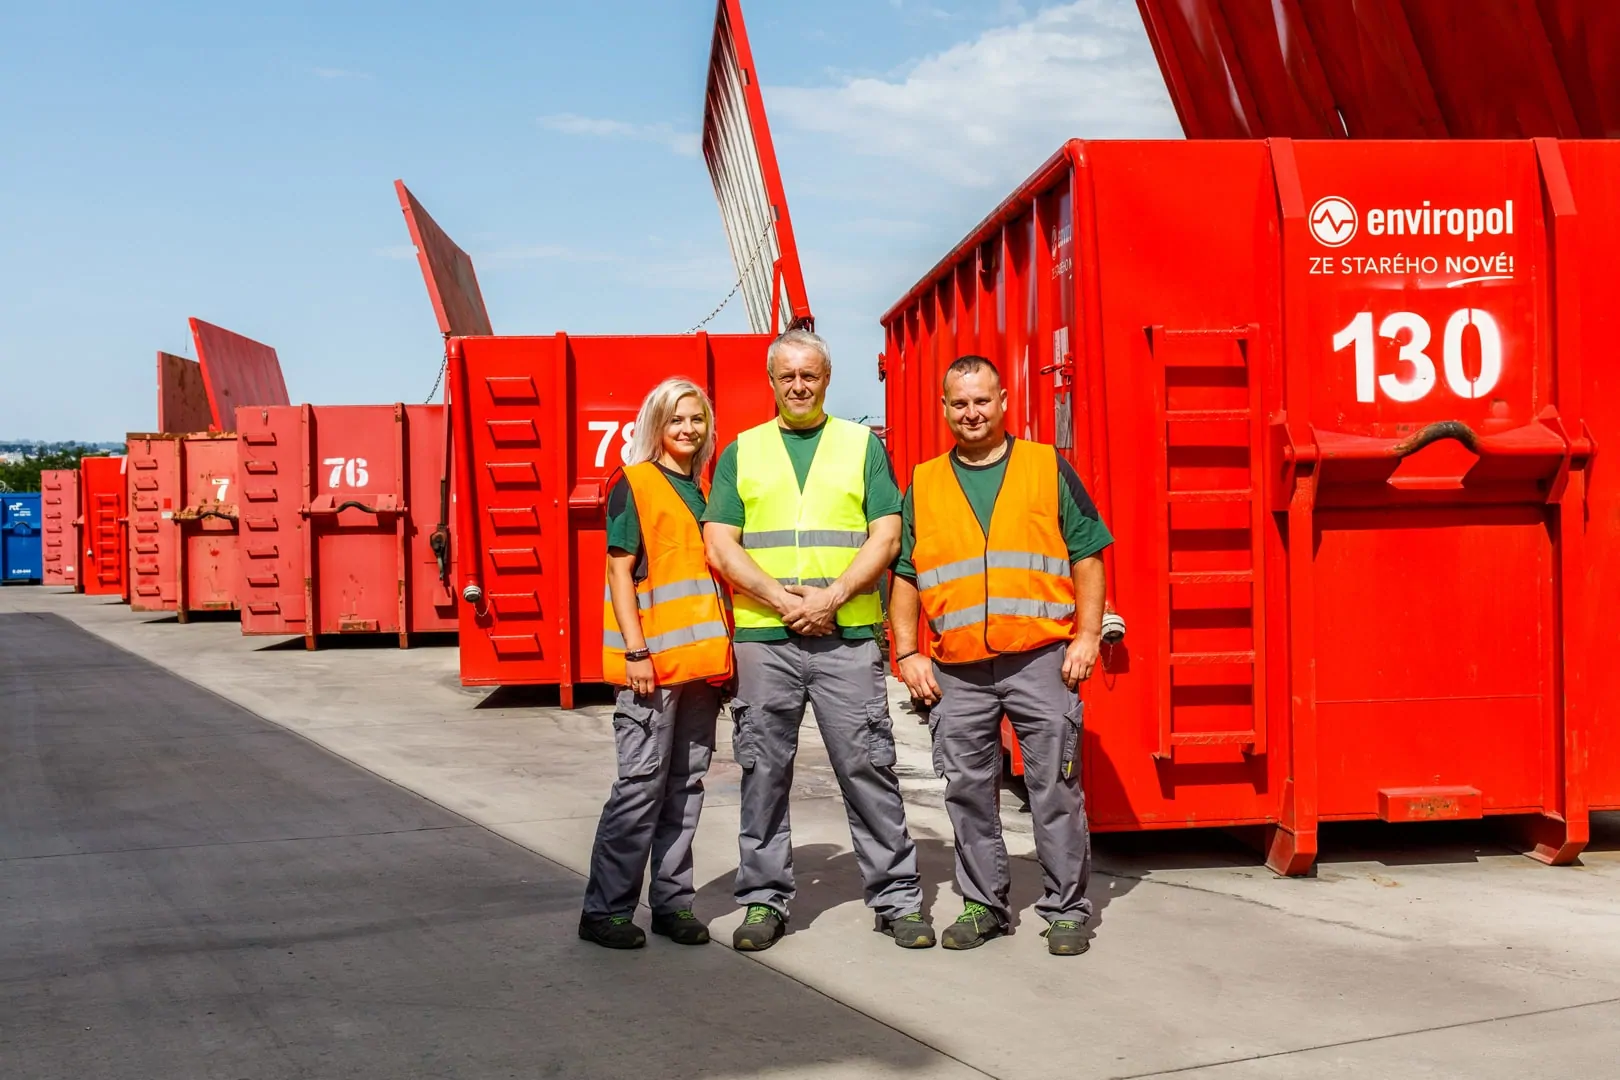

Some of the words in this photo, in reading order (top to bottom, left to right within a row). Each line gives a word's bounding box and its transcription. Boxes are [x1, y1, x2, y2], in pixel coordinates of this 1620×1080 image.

[1367, 199, 1513, 242] enviropol
[1309, 257, 1334, 274] ZE
[1341, 252, 1438, 274] STARÉHO
[1445, 252, 1514, 274] NOVÉ!
[1333, 308, 1503, 403] 130
[323, 457, 369, 489] 76
[211, 478, 230, 502] 7
